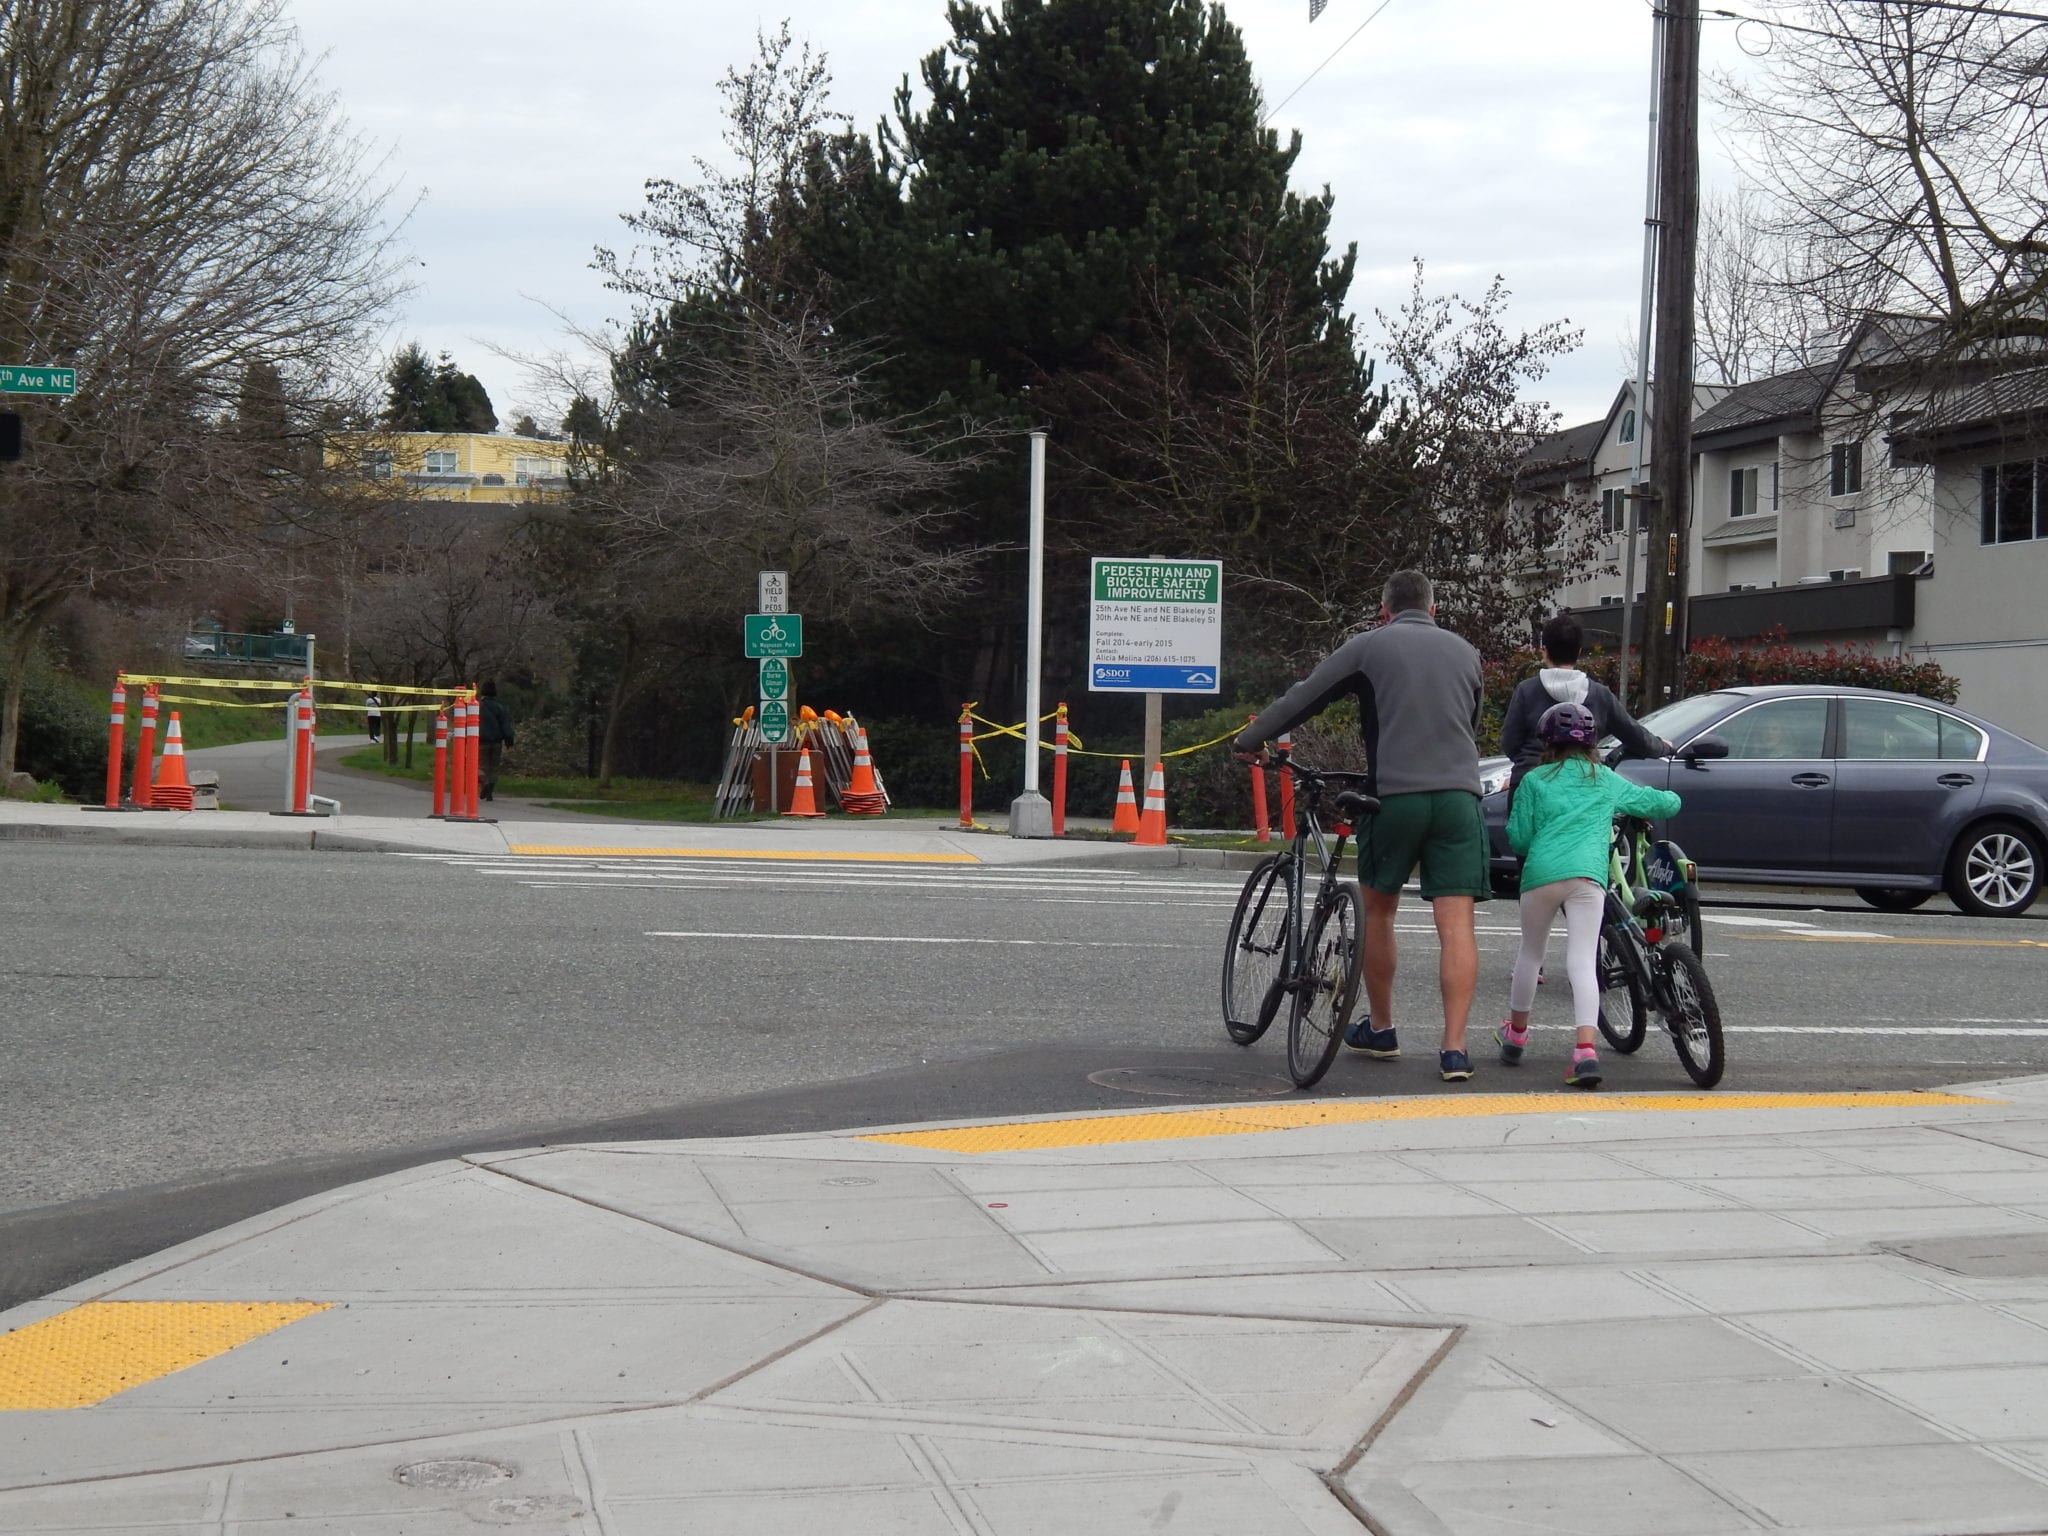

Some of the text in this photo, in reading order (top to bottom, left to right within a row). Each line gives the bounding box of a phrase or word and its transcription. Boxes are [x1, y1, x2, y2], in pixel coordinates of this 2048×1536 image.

[17, 373, 44, 387] Ave
[51, 374, 72, 388] NE
[1102, 565, 1212, 578] PEDESTRIAN AND
[1106, 576, 1208, 589] BICYCLE SAFETY
[1107, 587, 1206, 600] IMPROVEMENTS
[1095, 604, 1112, 612] 25th
[1114, 605, 1128, 613] Ave
[1173, 607, 1205, 615] Blakeley
[1207, 607, 1216, 615] St
[1095, 613, 1112, 621] 30th
[1114, 614, 1128, 622] Ave
[1143, 615, 1158, 623] and
[1159, 615, 1171, 623] NE
[1173, 616, 1205, 624] Blakeley
[1207, 616, 1216, 624] St
[1096, 638, 1111, 646] Fall
[1112, 639, 1153, 648] 2014-early
[1104, 669, 1131, 677] SDOT
